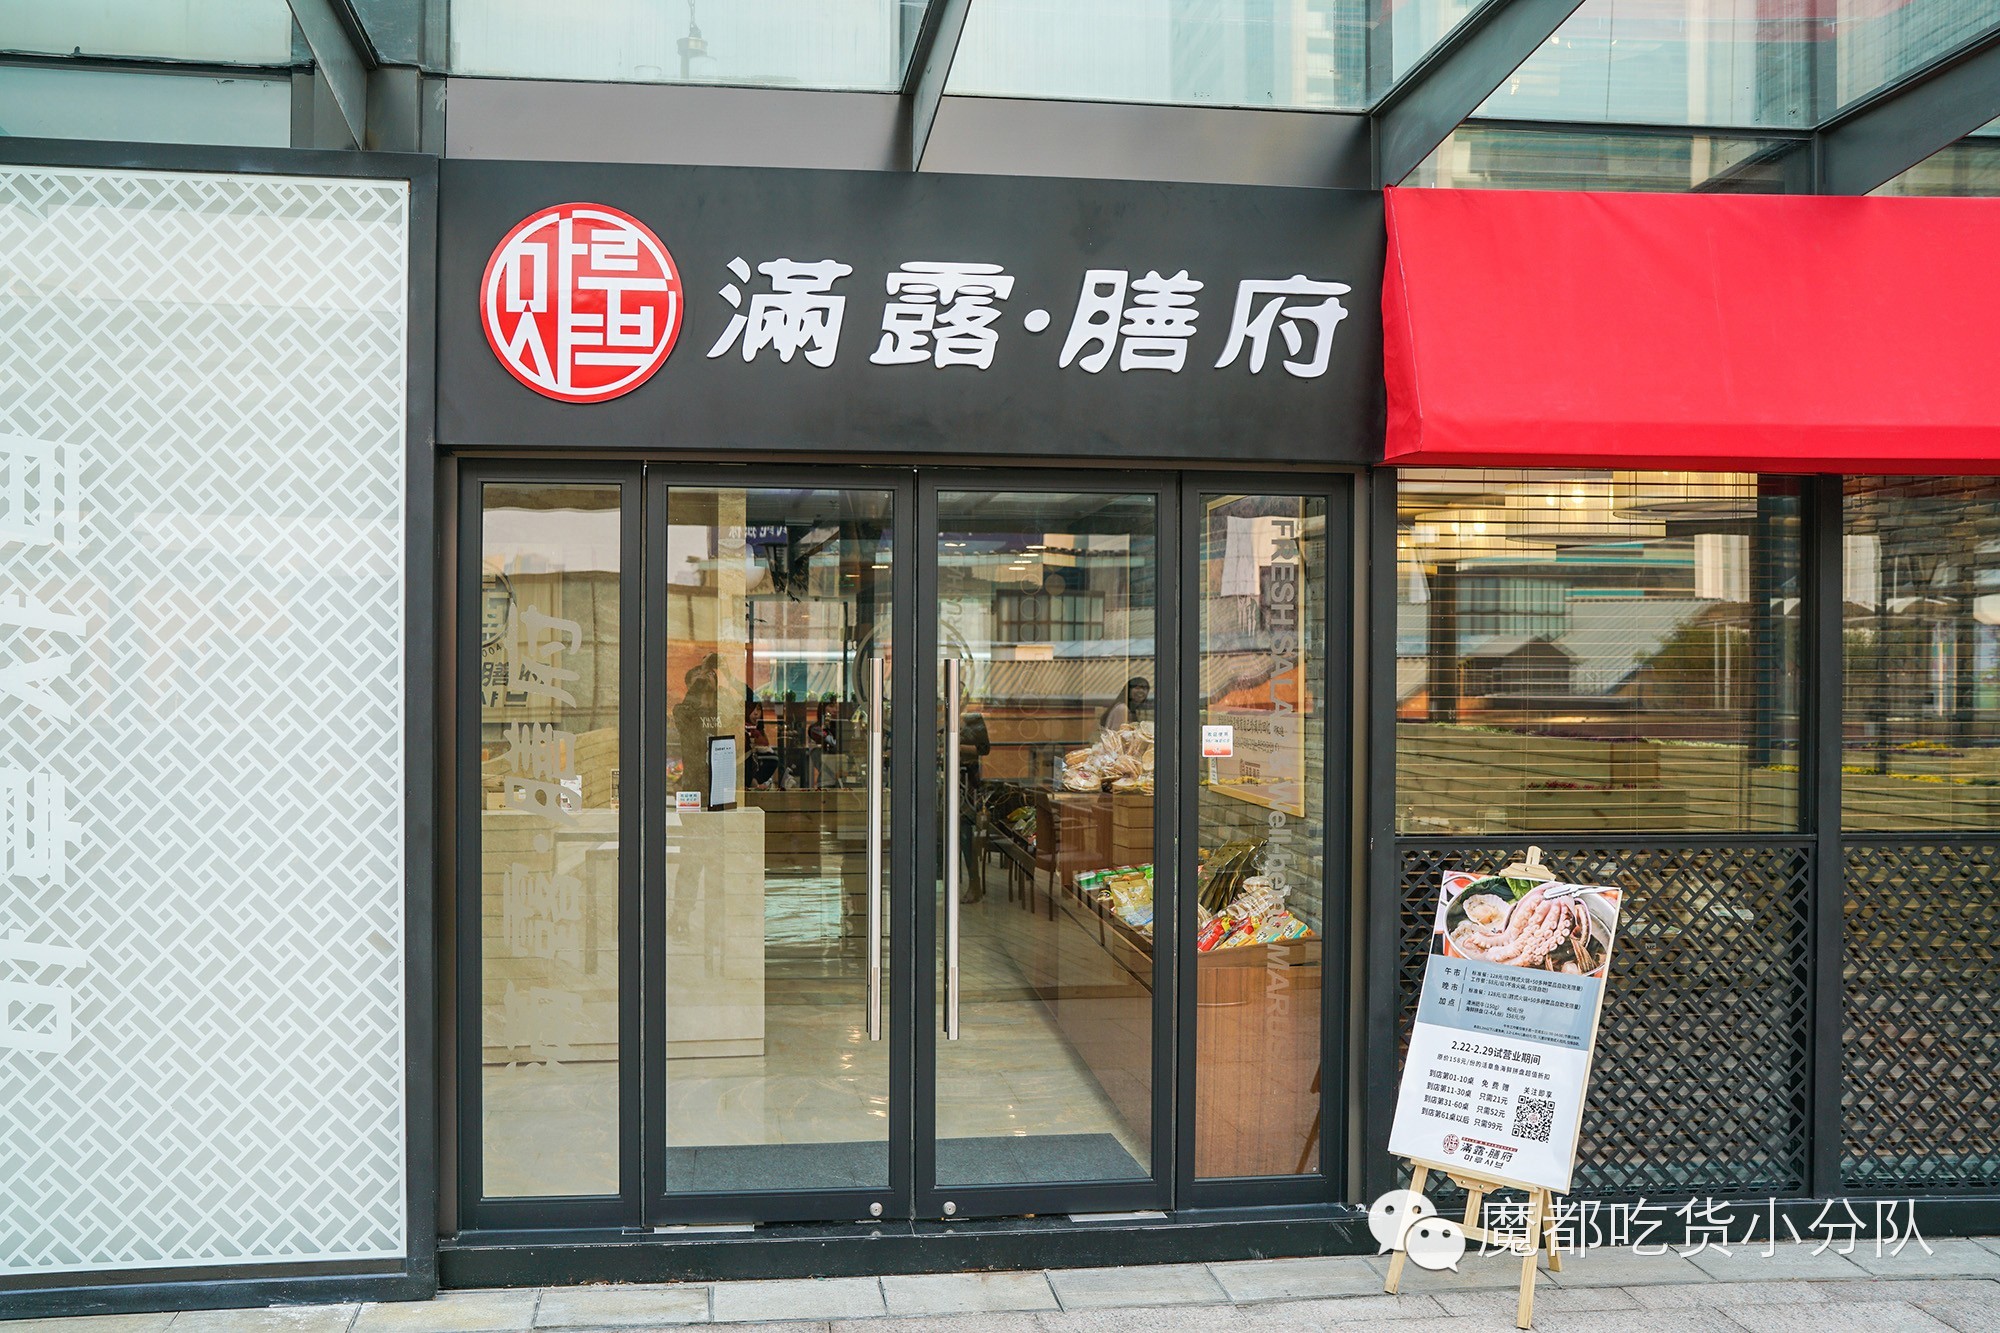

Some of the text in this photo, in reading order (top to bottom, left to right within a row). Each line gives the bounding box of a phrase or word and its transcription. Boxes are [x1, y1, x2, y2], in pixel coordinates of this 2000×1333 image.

[1271, 519, 1296, 625] FRESH
[1444, 967, 1461, 977] 午市
[1441, 981, 1459, 991] 晚市
[1438, 997, 1456, 1007] 加点
[1451, 1040, 1541, 1066] 2.22-2.29试营业期间
[1428, 1069, 1511, 1093] 到店第01-10桌 免费赠
[1523, 1086, 1553, 1099] 关注即享
[1426, 1082, 1509, 1106] 到店第11-30桌 只需21元
[1423, 1094, 1506, 1119] 到店第31-60桌 只需52元
[1421, 1107, 1504, 1132] 到店第61桌以后 只需99元
